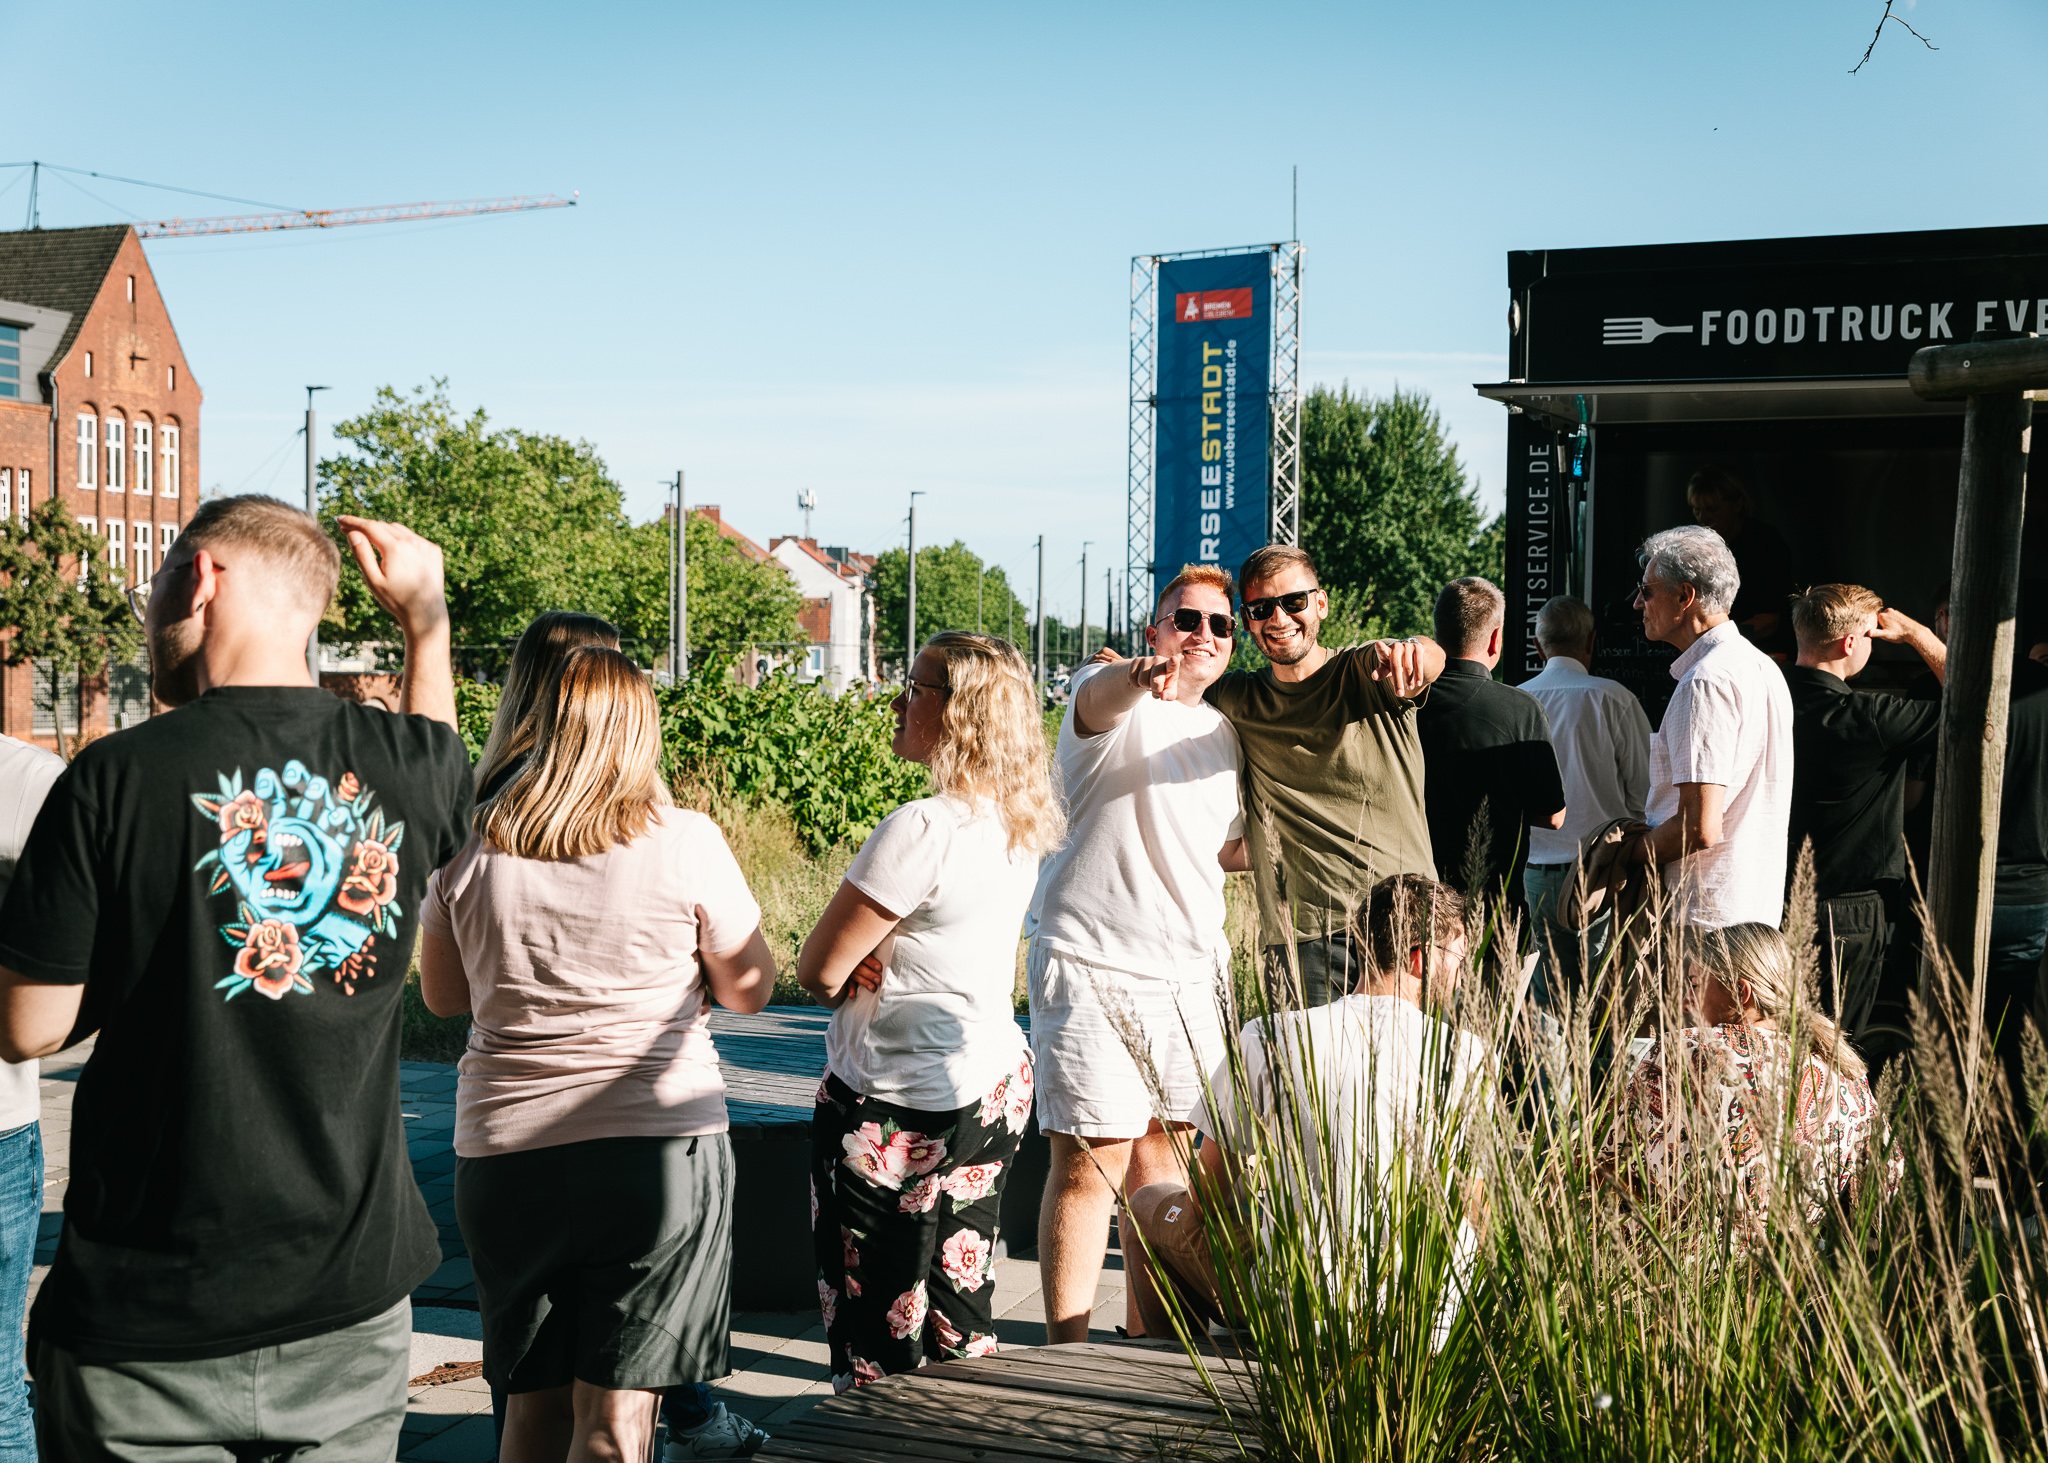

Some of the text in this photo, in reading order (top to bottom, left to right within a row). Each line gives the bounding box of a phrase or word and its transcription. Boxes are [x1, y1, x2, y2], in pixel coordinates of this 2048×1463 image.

[1203, 301, 1232, 311] BREMEN
[1701, 302, 1954, 346] FOODTRUCK
[1200, 341, 1223, 569] RSEESTADT
[1224, 339, 1237, 509] www.ueberseestadt.de
